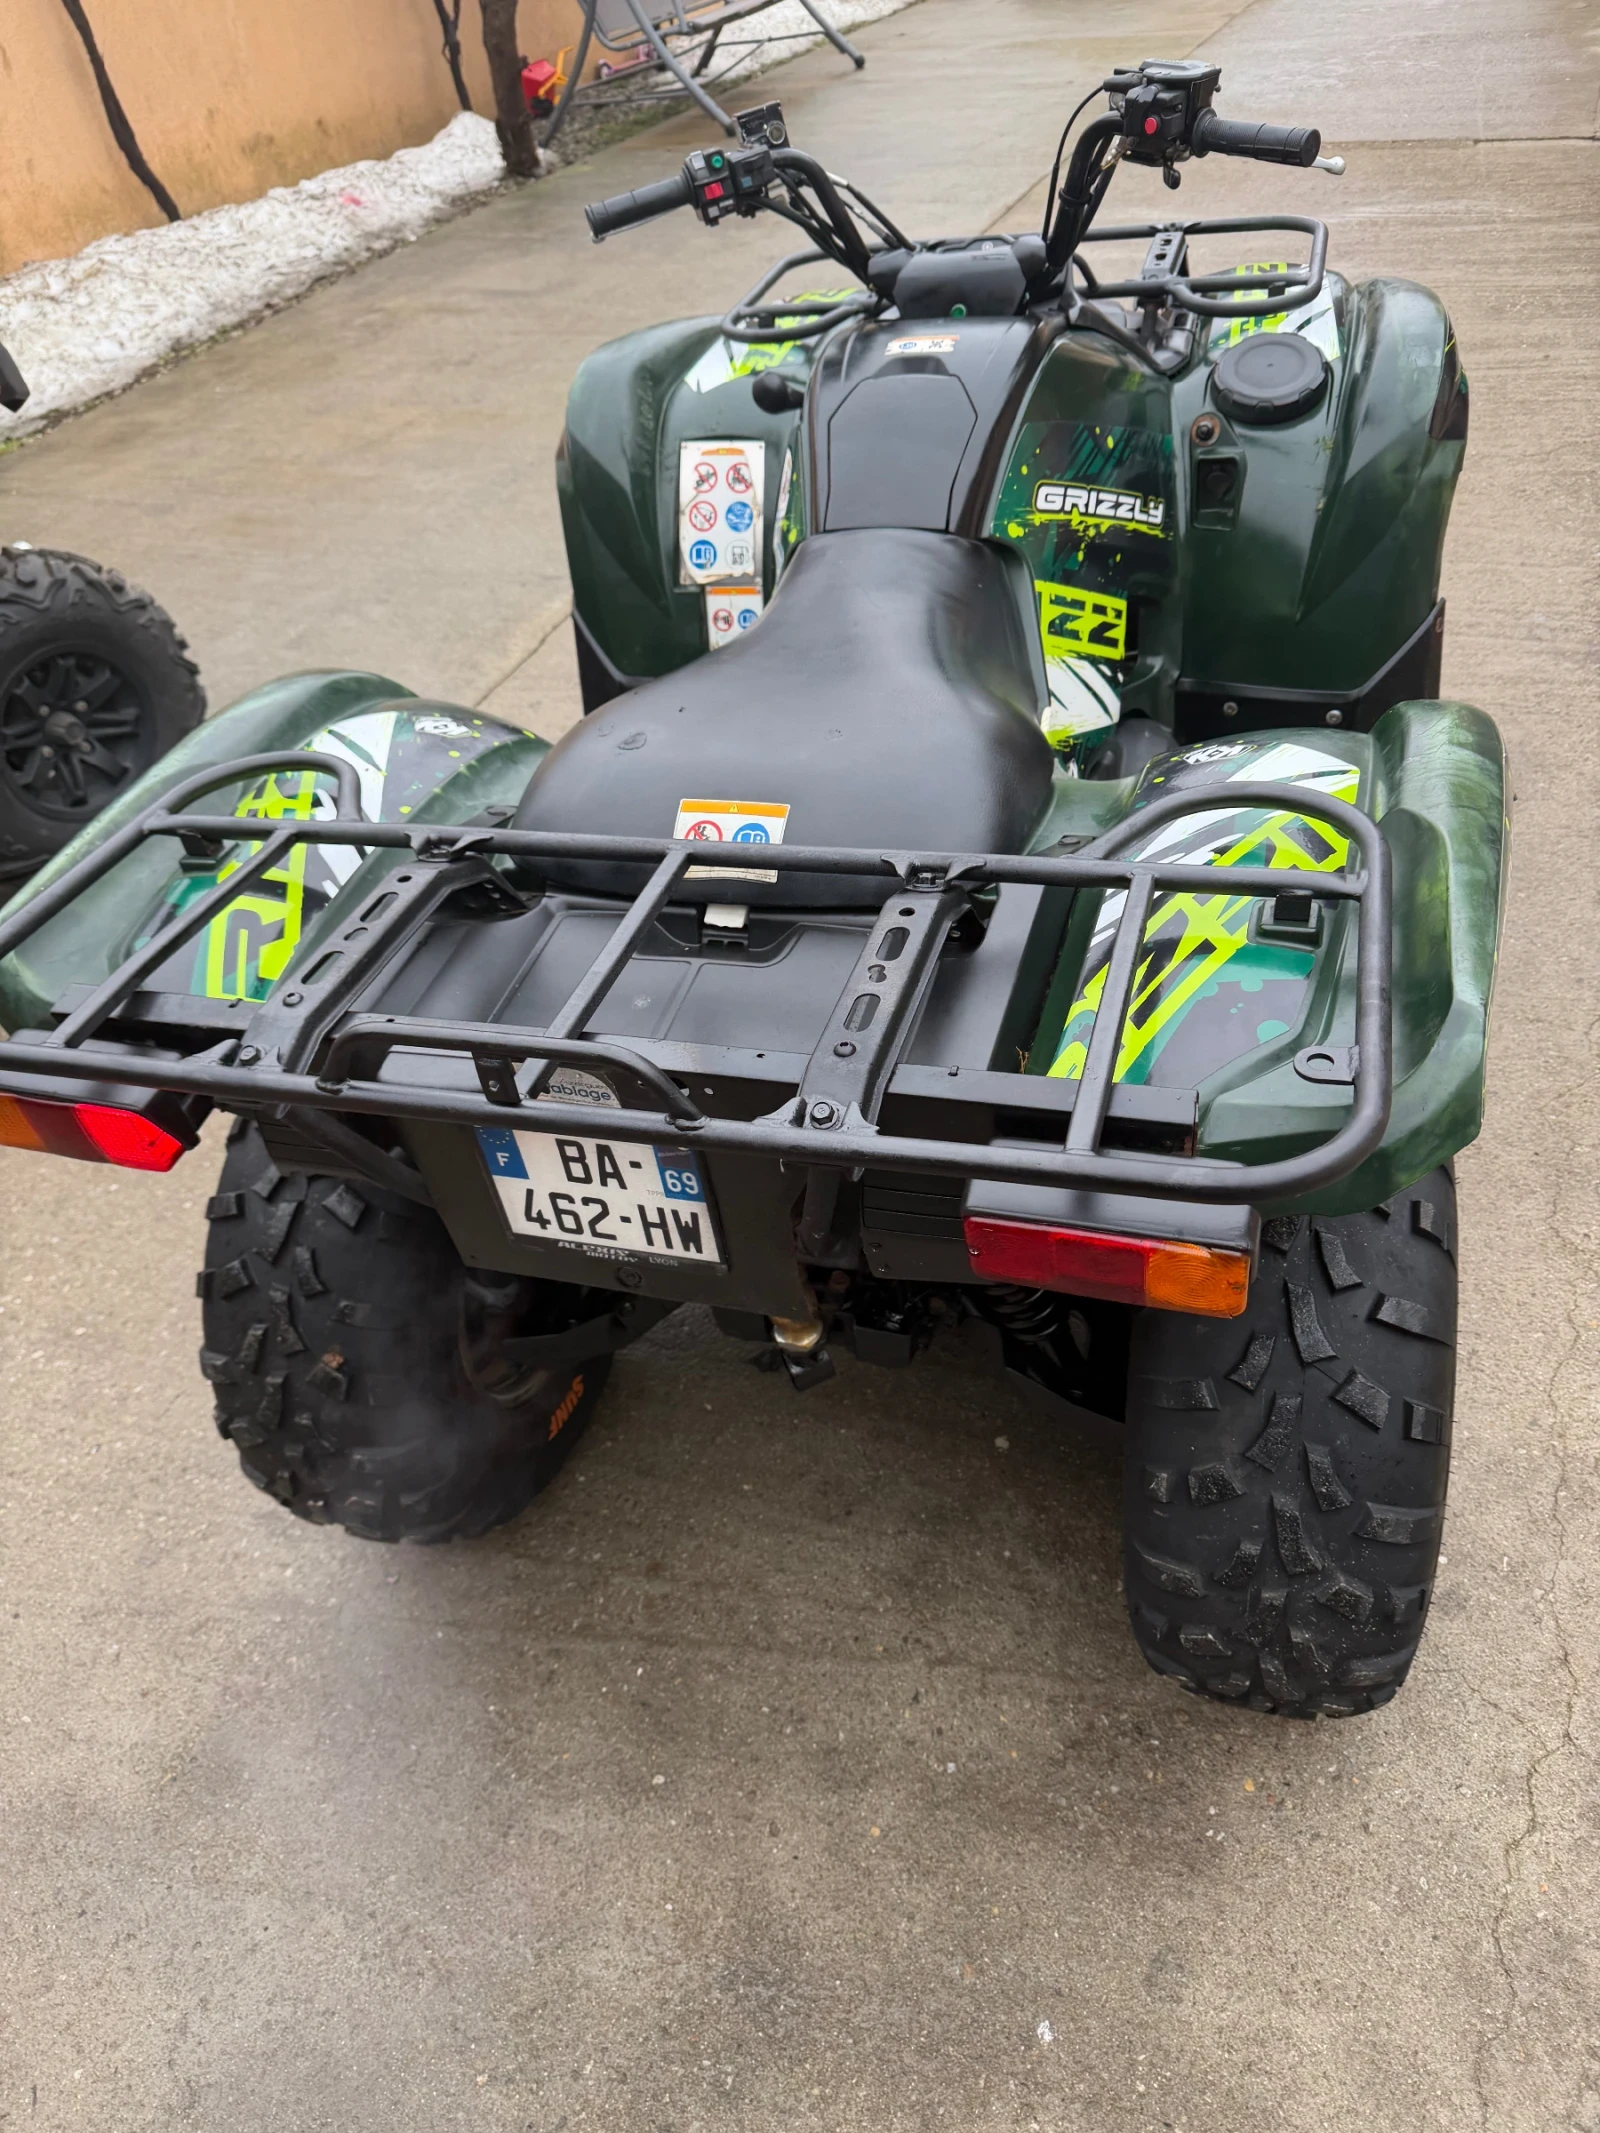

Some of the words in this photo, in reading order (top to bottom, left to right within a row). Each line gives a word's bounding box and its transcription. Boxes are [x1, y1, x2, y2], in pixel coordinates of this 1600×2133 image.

[1035, 485, 1165, 525] GRIZZLY
[496, 1152, 510, 1167] F
[664, 1169, 699, 1196] 69
[523, 1187, 704, 1255] 462-HW
[649, 1255, 679, 1267] LYON
